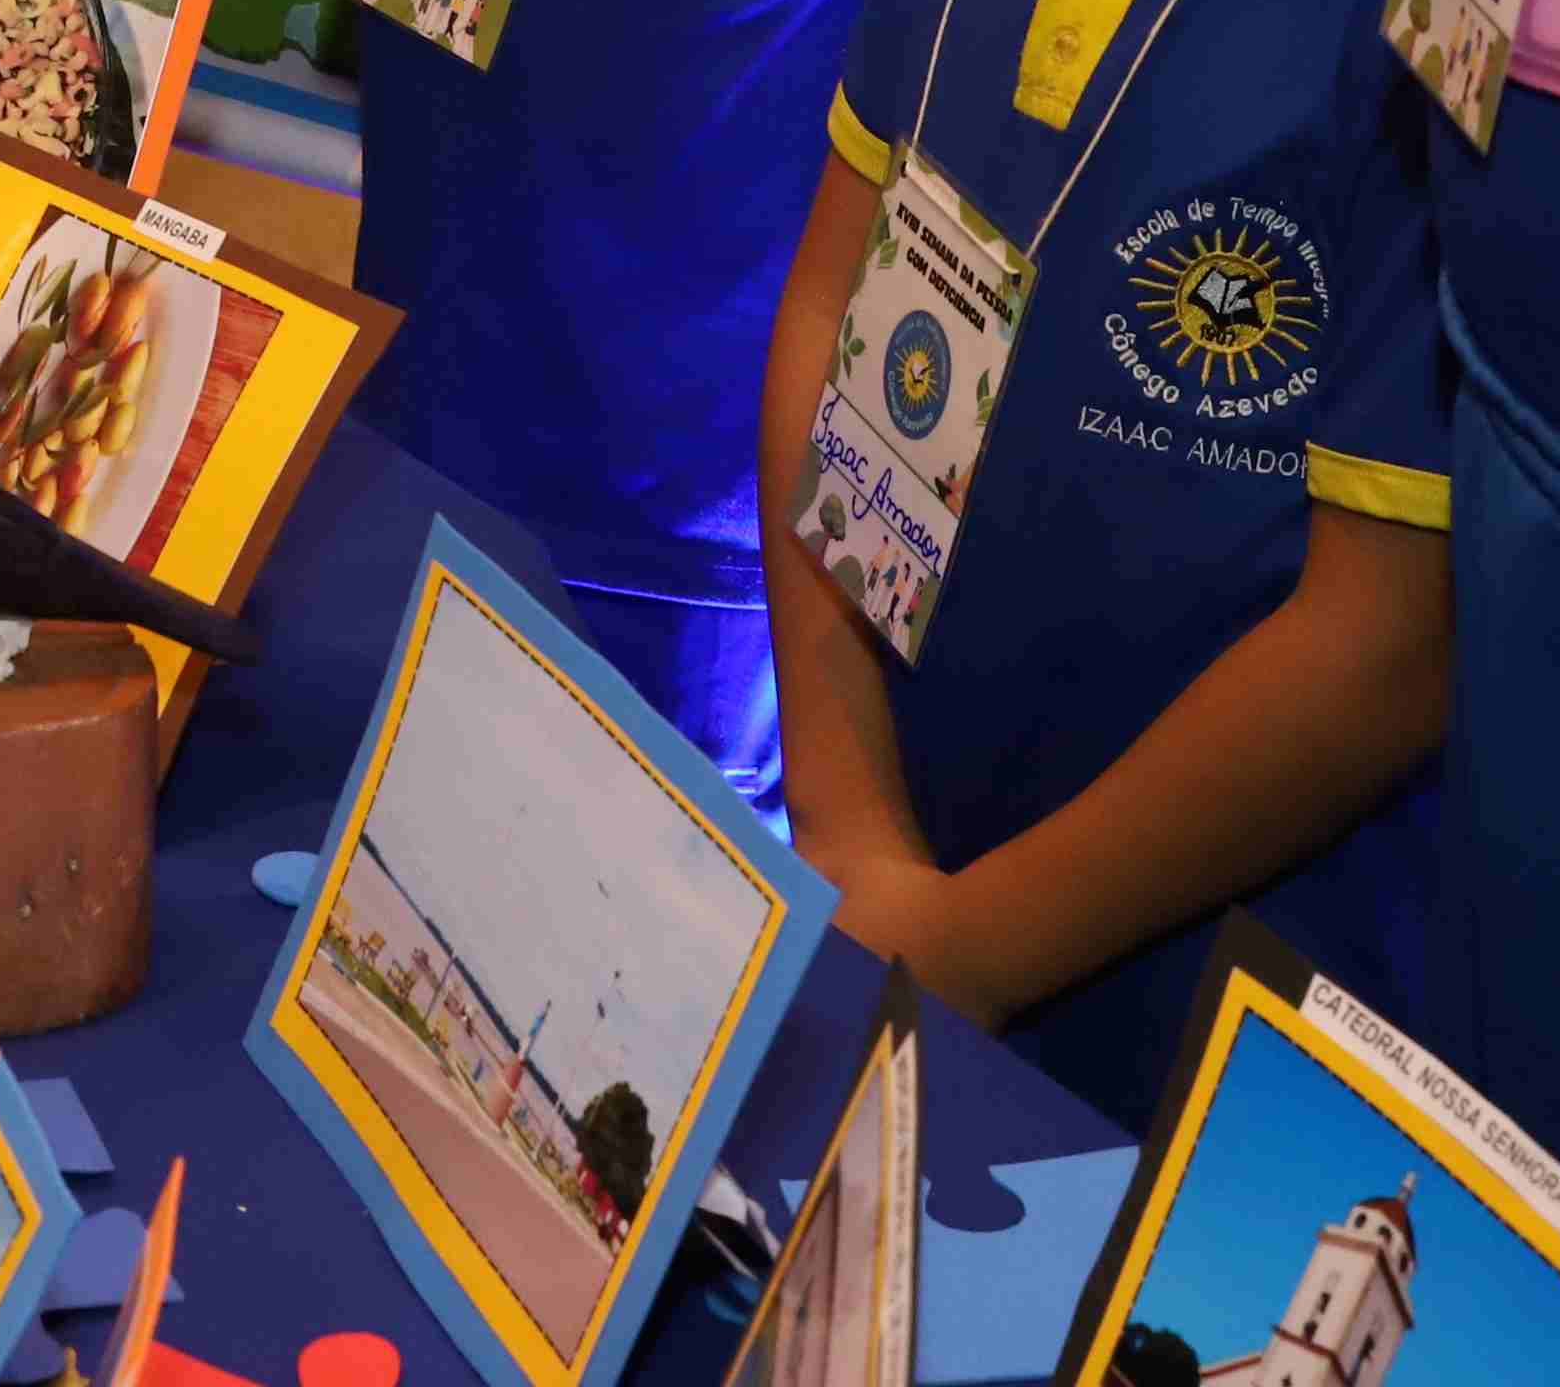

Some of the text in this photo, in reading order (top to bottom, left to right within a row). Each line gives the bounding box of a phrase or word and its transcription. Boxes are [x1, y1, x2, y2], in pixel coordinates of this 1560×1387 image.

[141, 208, 209, 251] MANGABA
[907, 246, 929, 276] COM
[1114, 208, 1181, 265] Escola
[1187, 198, 1216, 223] de
[1229, 196, 1299, 238] Tempo
[920, 226, 959, 273] SEMANA
[960, 262, 974, 288] DA
[976, 278, 1013, 326] PESSOA
[1104, 313, 1318, 420] Cônego Azevedo
[1078, 405, 1173, 452] IZAAC
[1311, 981, 1416, 1077] CATEDRAL
[1416, 1065, 1482, 1137] NOSSA
